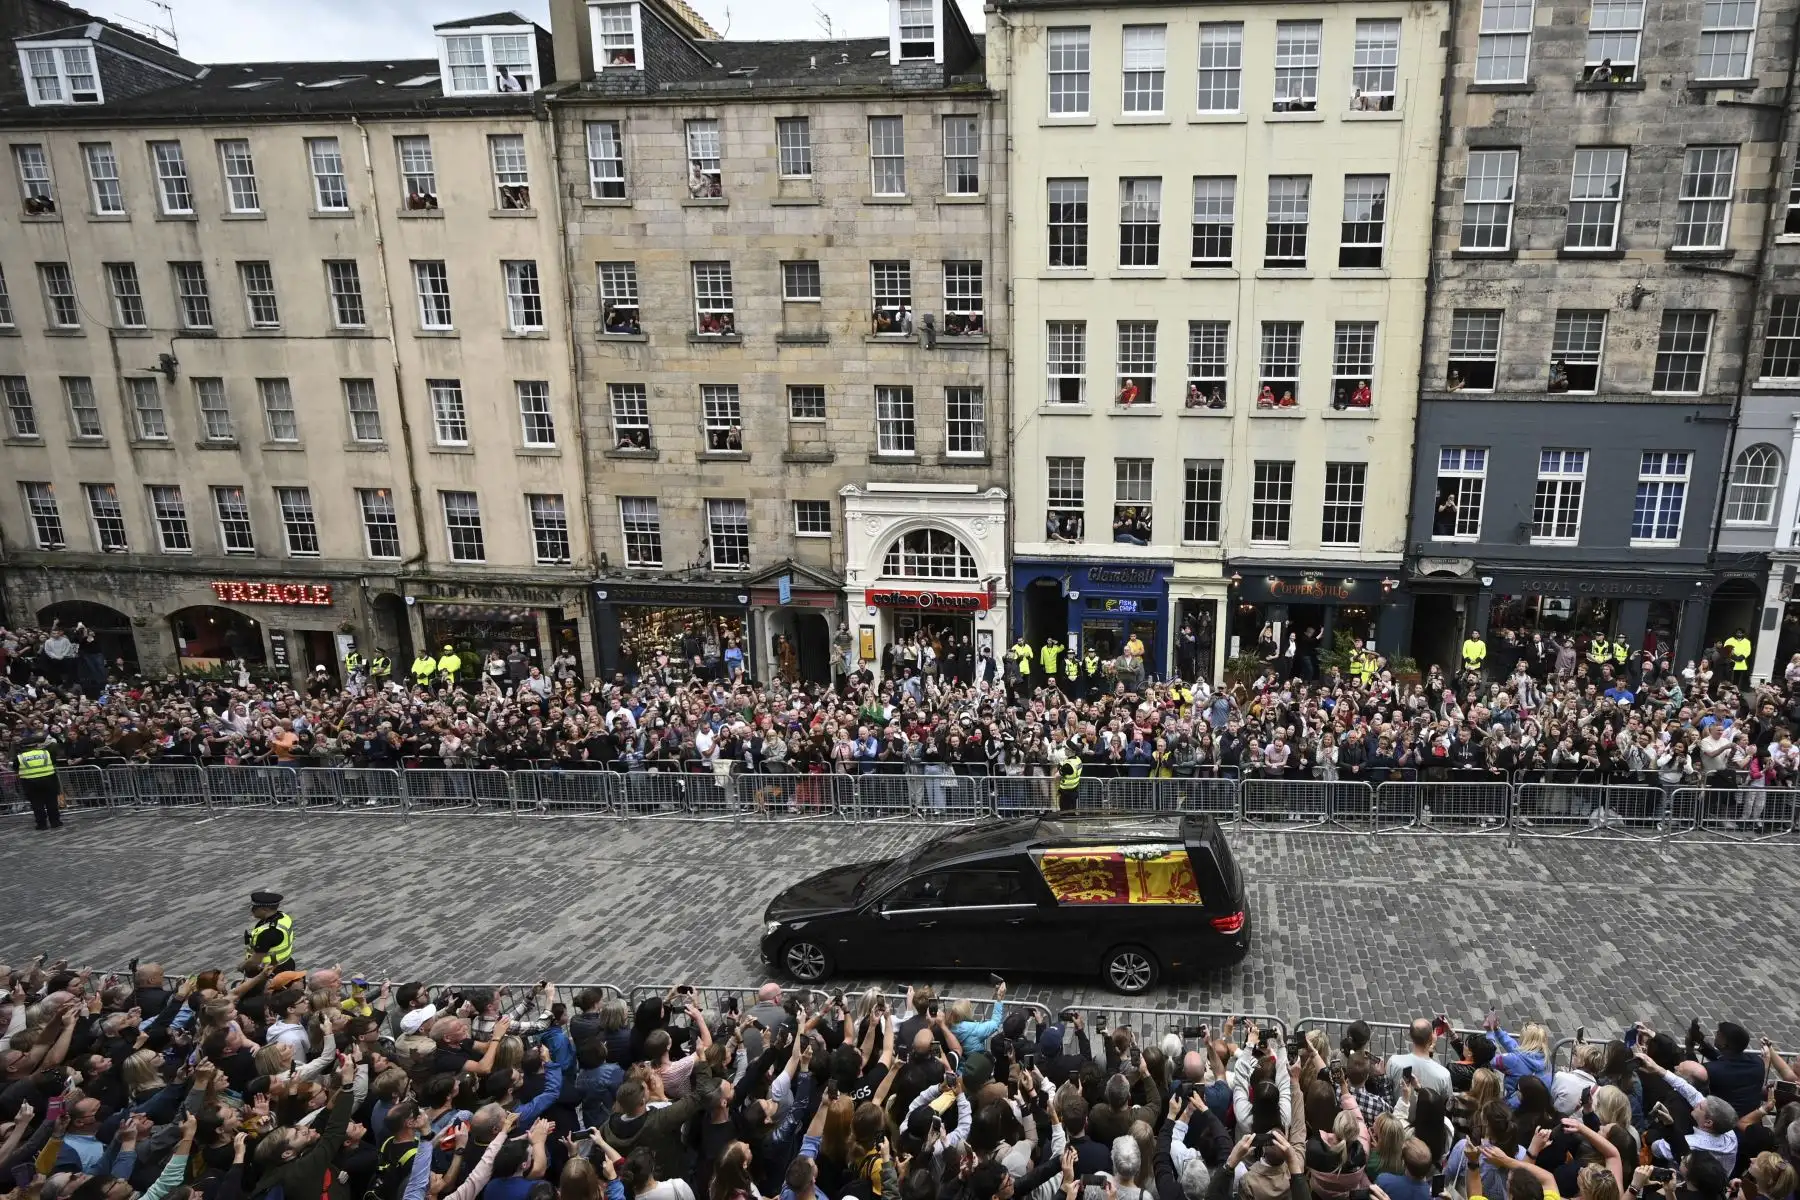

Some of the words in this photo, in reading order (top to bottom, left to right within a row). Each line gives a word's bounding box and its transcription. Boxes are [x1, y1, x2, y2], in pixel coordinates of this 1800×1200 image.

[211, 581, 332, 606] TREACLE
[504, 586, 563, 602] WHISKY
[1271, 581, 1313, 597] COPPER
[1313, 581, 1349, 599] STILL
[1521, 580, 1570, 592] ROYAL
[1578, 582, 1665, 595] CASHMERE
[872, 592, 917, 605] coffee
[934, 592, 980, 607] house
